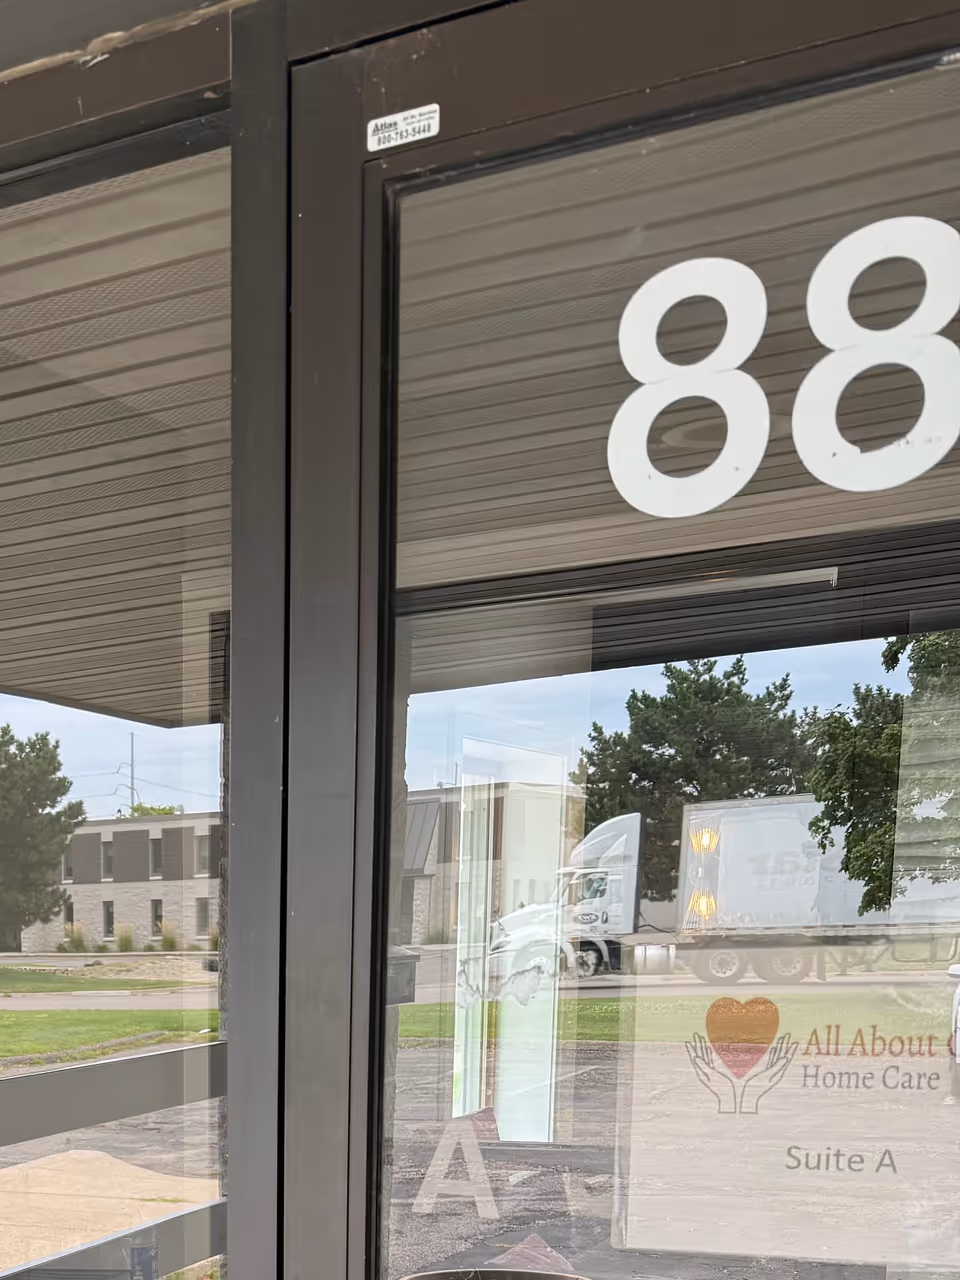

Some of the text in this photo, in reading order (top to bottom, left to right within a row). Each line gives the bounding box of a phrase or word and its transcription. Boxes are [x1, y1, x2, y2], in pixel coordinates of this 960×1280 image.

[373, 121, 397, 132] Atlas
[801, 1024, 841, 1057] All
[848, 1024, 937, 1058] About
[801, 1065, 941, 1090] Home Care
[411, 1119, 500, 1219] A
[785, 1145, 898, 1174] Suite A
